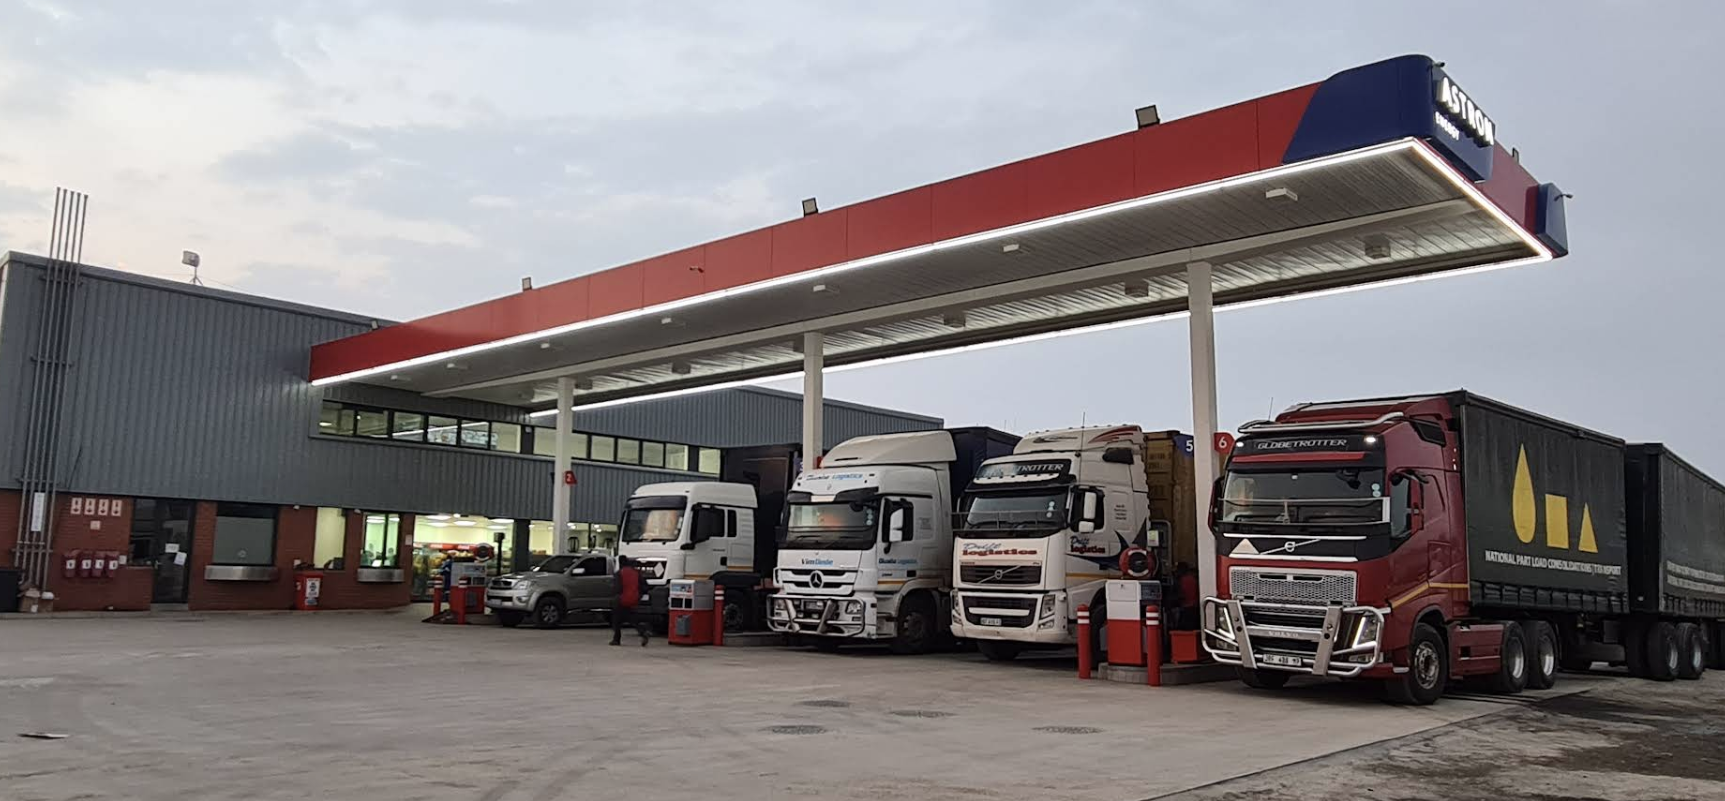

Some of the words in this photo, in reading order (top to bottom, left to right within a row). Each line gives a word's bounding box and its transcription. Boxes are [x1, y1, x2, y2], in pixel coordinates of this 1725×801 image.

[1441, 77, 1494, 146] ASTRON
[1435, 111, 1460, 141] ENERGY
[1186, 440, 1194, 452] 5
[1218, 437, 1227, 448] 6
[1257, 439, 1347, 449] GLOBETROTTER
[1485, 550, 1517, 565] NATIONAL
[1516, 555, 1532, 567] PART
[1532, 557, 1547, 568] LOAD
